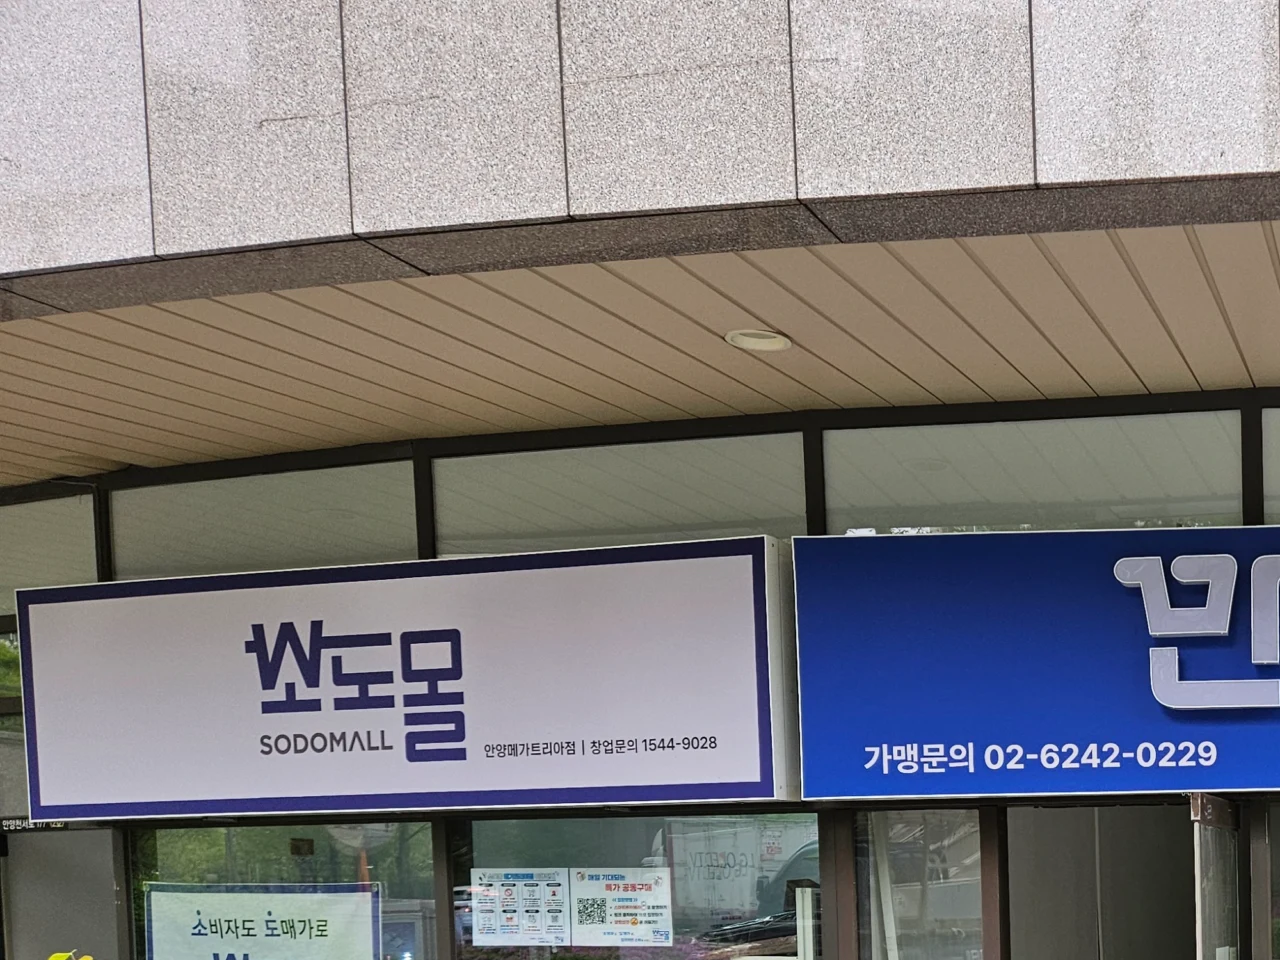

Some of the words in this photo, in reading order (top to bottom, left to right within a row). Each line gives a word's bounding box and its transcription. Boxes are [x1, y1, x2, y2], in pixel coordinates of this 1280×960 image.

[260, 730, 393, 755] SODOMALL
[483, 741, 576, 758] 안양메가트리아점
[590, 739, 638, 755] 창업문의
[642, 736, 718, 752] 1544-9028
[863, 741, 975, 774] 가맹문의
[983, 740, 1218, 770] 02-6242-0229
[191, 910, 257, 939] 소비자도
[264, 911, 328, 940] 도매가로
